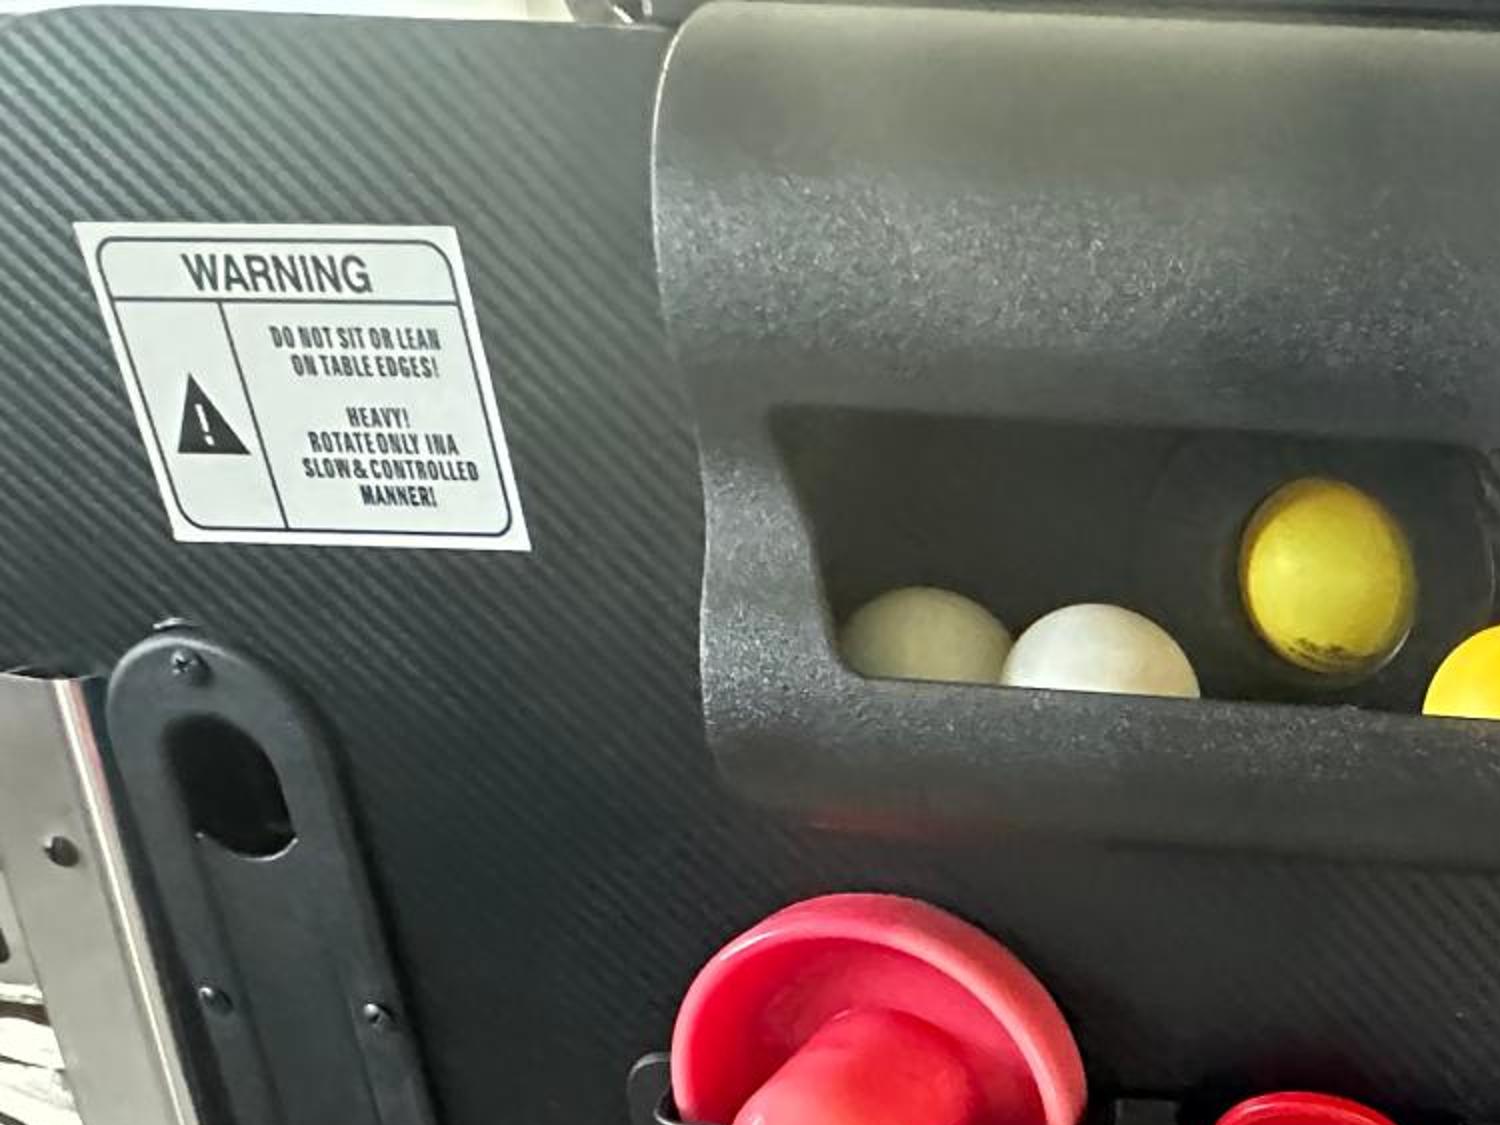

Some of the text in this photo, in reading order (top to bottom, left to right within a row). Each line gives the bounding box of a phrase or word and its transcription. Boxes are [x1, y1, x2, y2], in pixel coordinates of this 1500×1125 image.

[181, 253, 373, 294] WARNING
[269, 325, 442, 351] DO NOT SIT OR LEAN
[291, 354, 440, 379] ON TABLE EDGES!
[346, 407, 410, 429] HEAVY!
[307, 431, 376, 454] ROTATE
[376, 432, 420, 455] ONLY
[302, 457, 480, 482] SLOW & CONTROLLED
[360, 485, 438, 508] MANNER!
